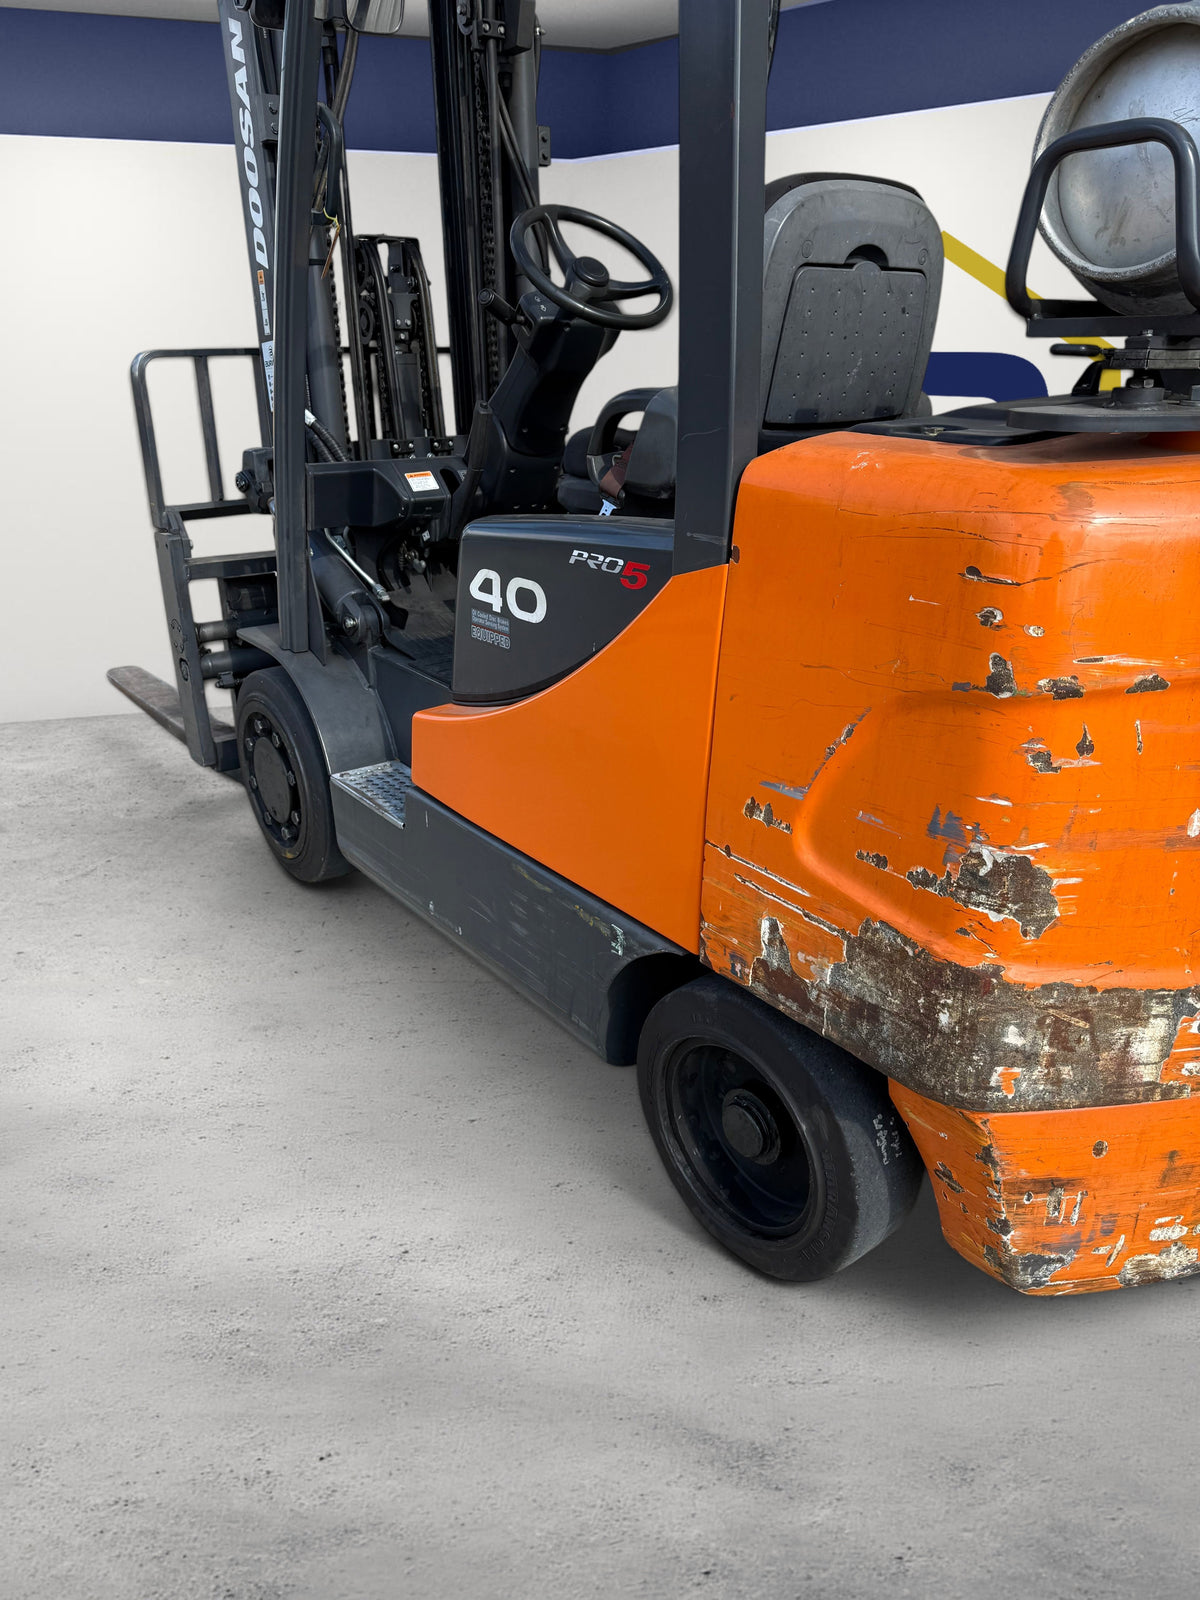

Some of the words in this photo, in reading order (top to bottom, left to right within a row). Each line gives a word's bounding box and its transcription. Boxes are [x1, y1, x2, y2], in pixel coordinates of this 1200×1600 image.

[228, 18, 269, 269] DOOSAN
[469, 568, 547, 624] 40
[471, 625, 510, 649] EQUIPPED
